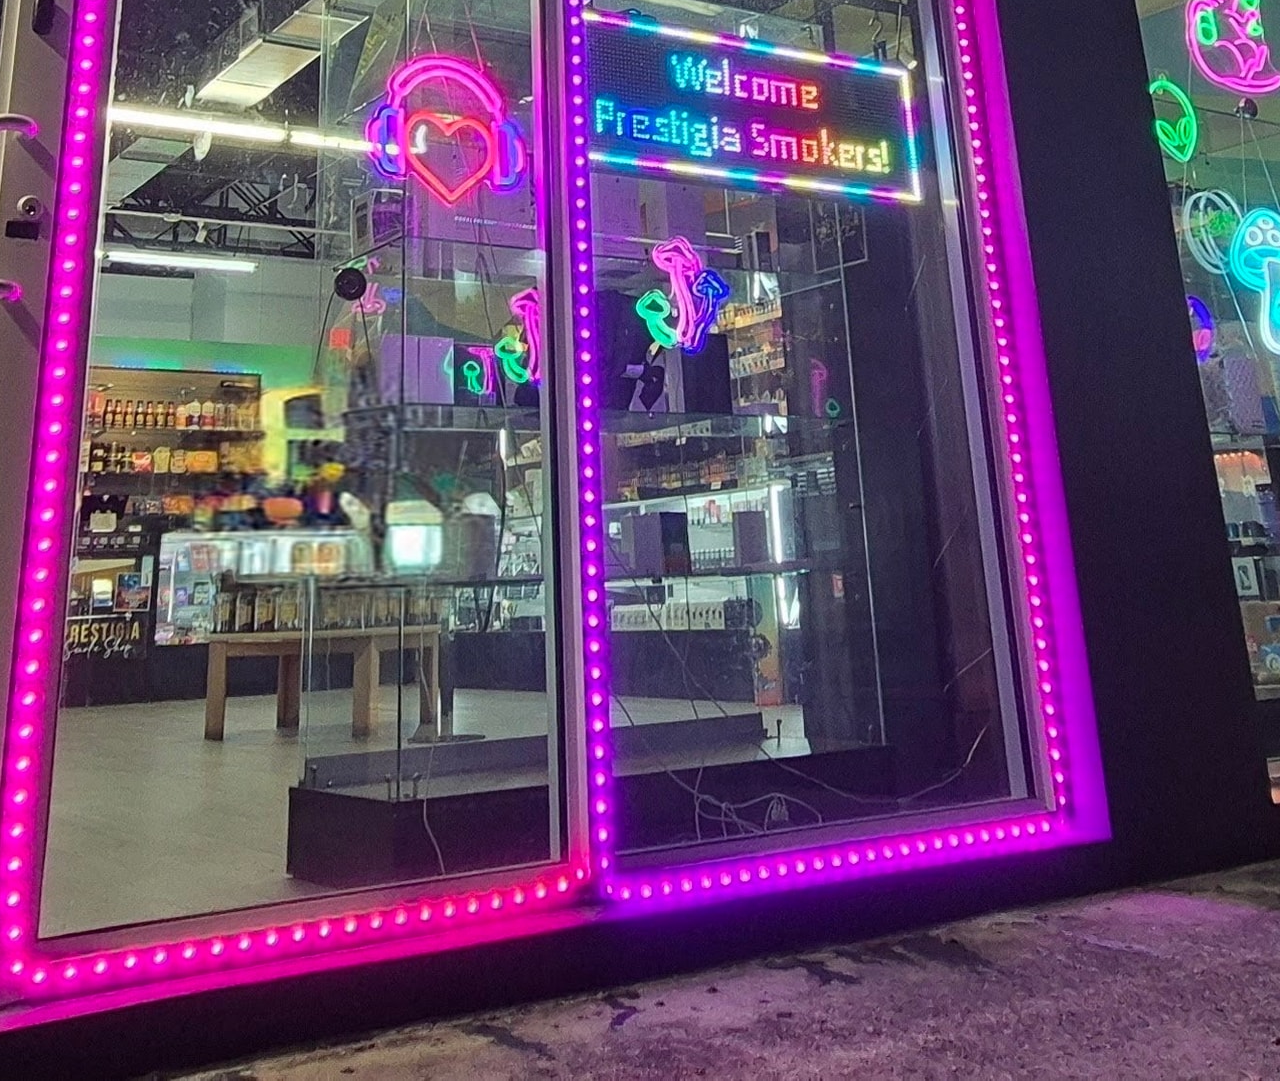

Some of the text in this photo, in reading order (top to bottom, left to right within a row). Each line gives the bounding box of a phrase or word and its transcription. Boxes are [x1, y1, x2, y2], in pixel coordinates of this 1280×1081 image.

[670, 54, 819, 109] Welcome
[594, 98, 891, 173] Prestigia Smokers!
